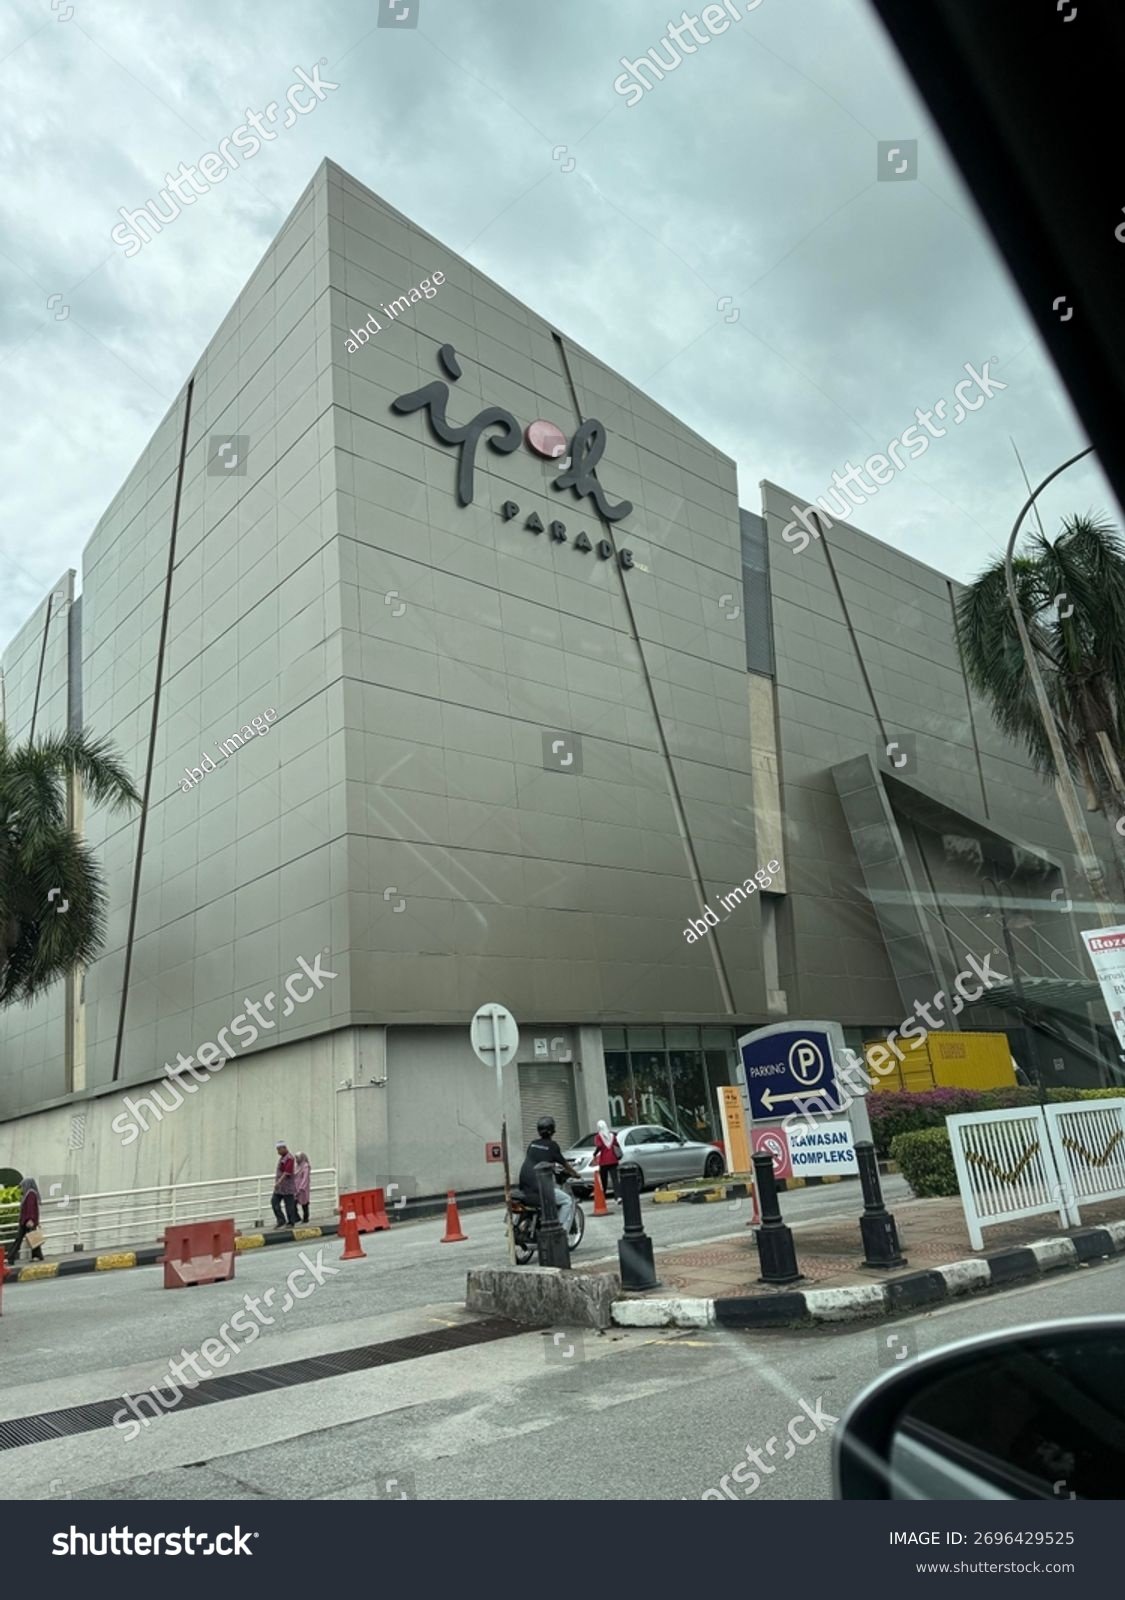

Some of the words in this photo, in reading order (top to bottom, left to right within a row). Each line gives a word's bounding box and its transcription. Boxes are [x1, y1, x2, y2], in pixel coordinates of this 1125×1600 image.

[502, 500, 634, 570] PARADE
[750, 1062, 786, 1078] PARKING
[792, 1149, 855, 1165] KOMPLEKS
